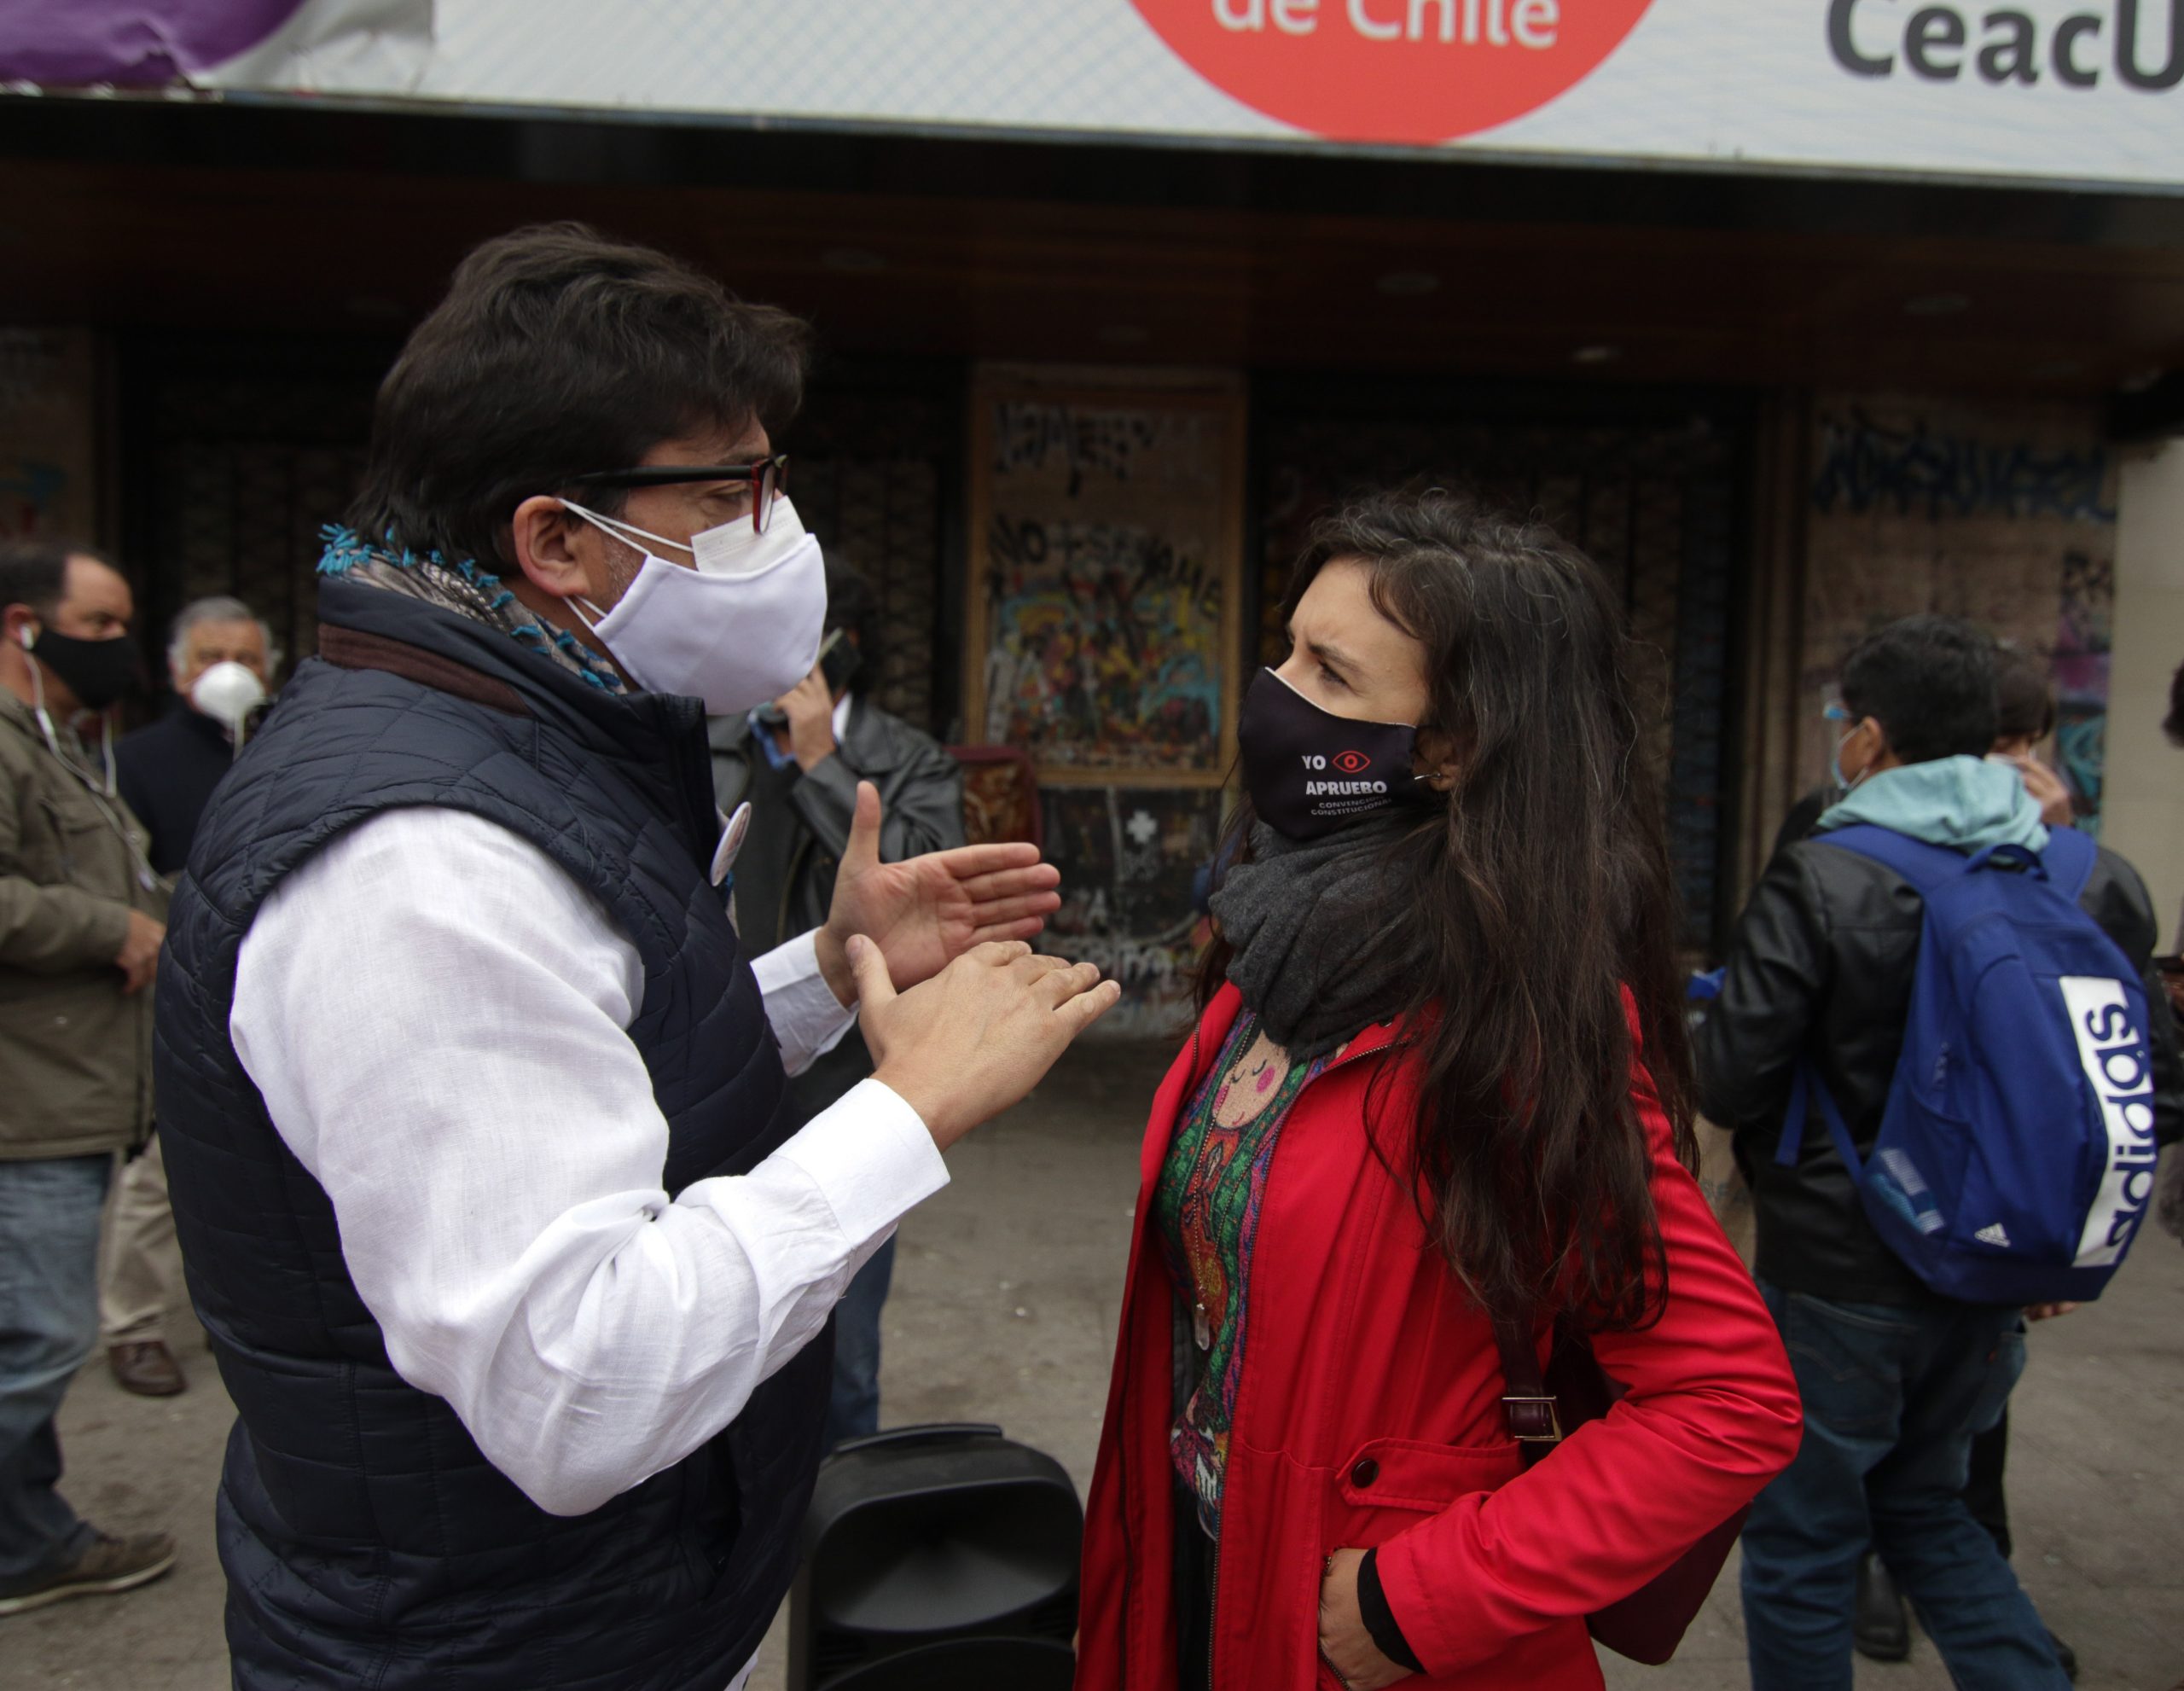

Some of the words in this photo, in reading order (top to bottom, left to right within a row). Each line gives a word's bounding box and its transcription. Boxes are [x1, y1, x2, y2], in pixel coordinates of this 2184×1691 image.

[1345, 0, 1560, 49] Chile
[1827, 0, 2184, 91] CeacU
[1301, 755, 1327, 770] YO
[1305, 780, 1387, 795] APRUEBO
[2085, 1002, 2155, 1247] adidas
